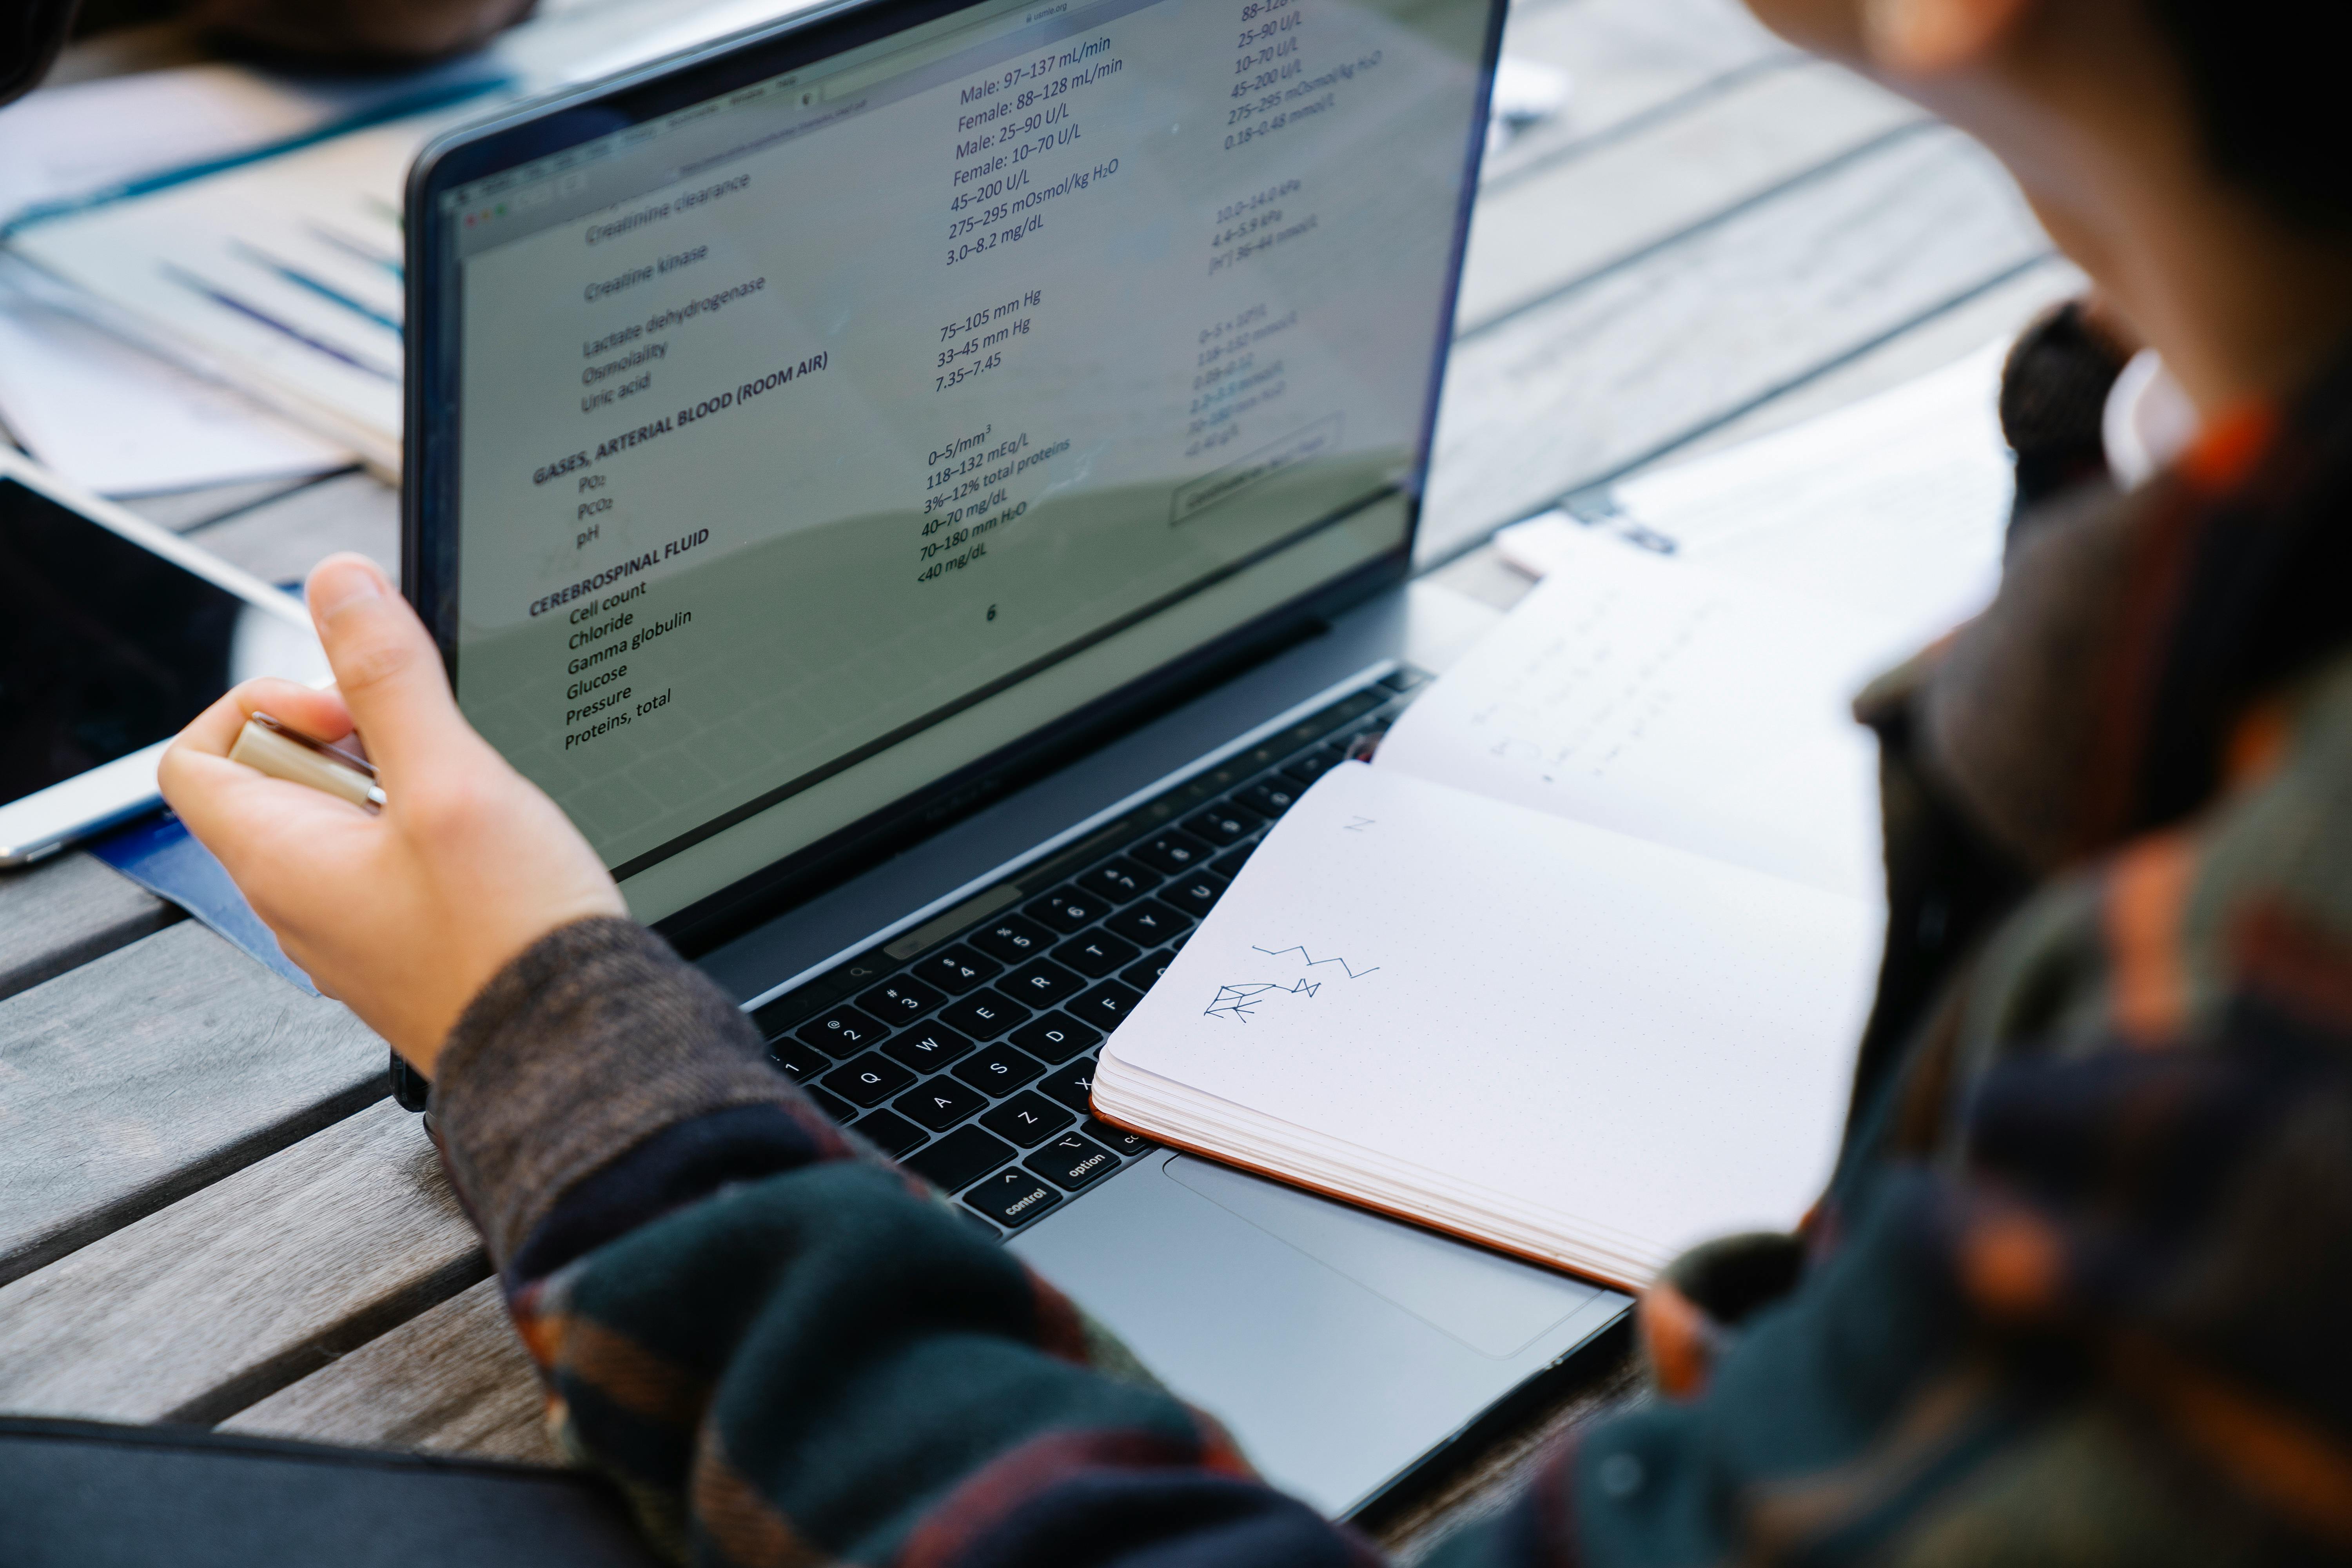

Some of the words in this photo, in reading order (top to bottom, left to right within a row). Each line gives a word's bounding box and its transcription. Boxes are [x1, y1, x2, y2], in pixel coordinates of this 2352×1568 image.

[960, 79, 1000, 105] Male:
[1004, 56, 1055, 89] 97–137
[1059, 37, 1111, 68] mL/min
[958, 101, 1013, 132] Female:
[1016, 77, 1067, 110] 88–128
[1071, 58, 1123, 89] mL/min
[955, 134, 995, 159] Male:
[999, 113, 1041, 143] 25–90
[1045, 102, 1069, 124] U/L
[953, 155, 1007, 187] Female:
[1012, 134, 1054, 163] 10–70
[1058, 123, 1081, 145] U/L
[585, 202, 670, 246] Creatinine
[673, 172, 750, 211] clearance
[949, 203, 1008, 240] 275–295
[1012, 172, 1089, 214] mOsmol/kg
[951, 180, 1002, 212] 45–200
[1006, 169, 1030, 191] U/L
[946, 232, 996, 265] 3.0–8.2
[1000, 213, 1044, 244] mg/dL
[584, 264, 653, 302] Creatine
[657, 243, 708, 274] kinase
[582, 323, 642, 358] Lactate
[646, 276, 766, 334] dehydrogenase
[940, 309, 989, 342] 75–105
[993, 299, 1020, 319] mm
[1024, 289, 1041, 307] Hg
[937, 338, 979, 368] 33–45
[983, 328, 1009, 348] mm
[1013, 318, 1031, 335] Hg
[581, 341, 668, 386] Osmolality
[936, 352, 1002, 392] 7.35–7.45
[581, 391, 614, 414] Uric
[618, 371, 651, 399] acid
[532, 451, 593, 486] GASES,
[594, 417, 673, 461] ARTERIAL
[677, 392, 732, 427] BLOOD
[736, 367, 793, 405] (ROOM
[796, 351, 829, 378] AIR)
[924, 477, 980, 514] 3%–12%
[983, 461, 1014, 487] total
[1017, 438, 1071, 474] proteins
[926, 453, 984, 490] 118–132
[987, 432, 1029, 463] mEq/L
[922, 508, 962, 537] 40–70
[966, 488, 1008, 518] mg/dL
[576, 524, 600, 550] pH
[920, 528, 968, 561] 70–180
[971, 516, 997, 537] mm
[528, 549, 660, 617] CEREBROSPINAL
[664, 528, 709, 560] FLUID
[917, 562, 942, 583] <40
[945, 542, 987, 572] mg/dL
[569, 600, 599, 626] Cell
[602, 581, 647, 612] count
[986, 604, 997, 621] 6
[567, 640, 628, 675] Gamma
[631, 611, 692, 650] globulin
[568, 612, 633, 651] Chloride
[566, 664, 628, 701] Glucose
[564, 713, 632, 751] Proteins,
[636, 688, 671, 717] total
[566, 686, 632, 726] Pressure
[1191, 885, 1212, 898] U
[1067, 906, 1085, 918] 6
[1139, 915, 1156, 926] Y
[1013, 936, 1031, 947] 5
[1085, 945, 1103, 956] T
[960, 967, 975, 977] 4
[1031, 976, 1051, 989] R
[901, 998, 918, 1009] 3
[976, 1007, 995, 1019] E
[1102, 998, 1116, 1010] F
[827, 1020, 840, 1029] @
[843, 1030, 861, 1041] 2
[1045, 1030, 1065, 1043] D
[915, 1037, 939, 1053] W
[785, 1063, 800, 1072] 1
[860, 1073, 882, 1084] Q
[990, 1063, 1008, 1074] S
[933, 1097, 952, 1109] A
[1017, 1111, 1039, 1124] Z
[1069, 1154, 1106, 1178] option
[1005, 1188, 1047, 1216] control
